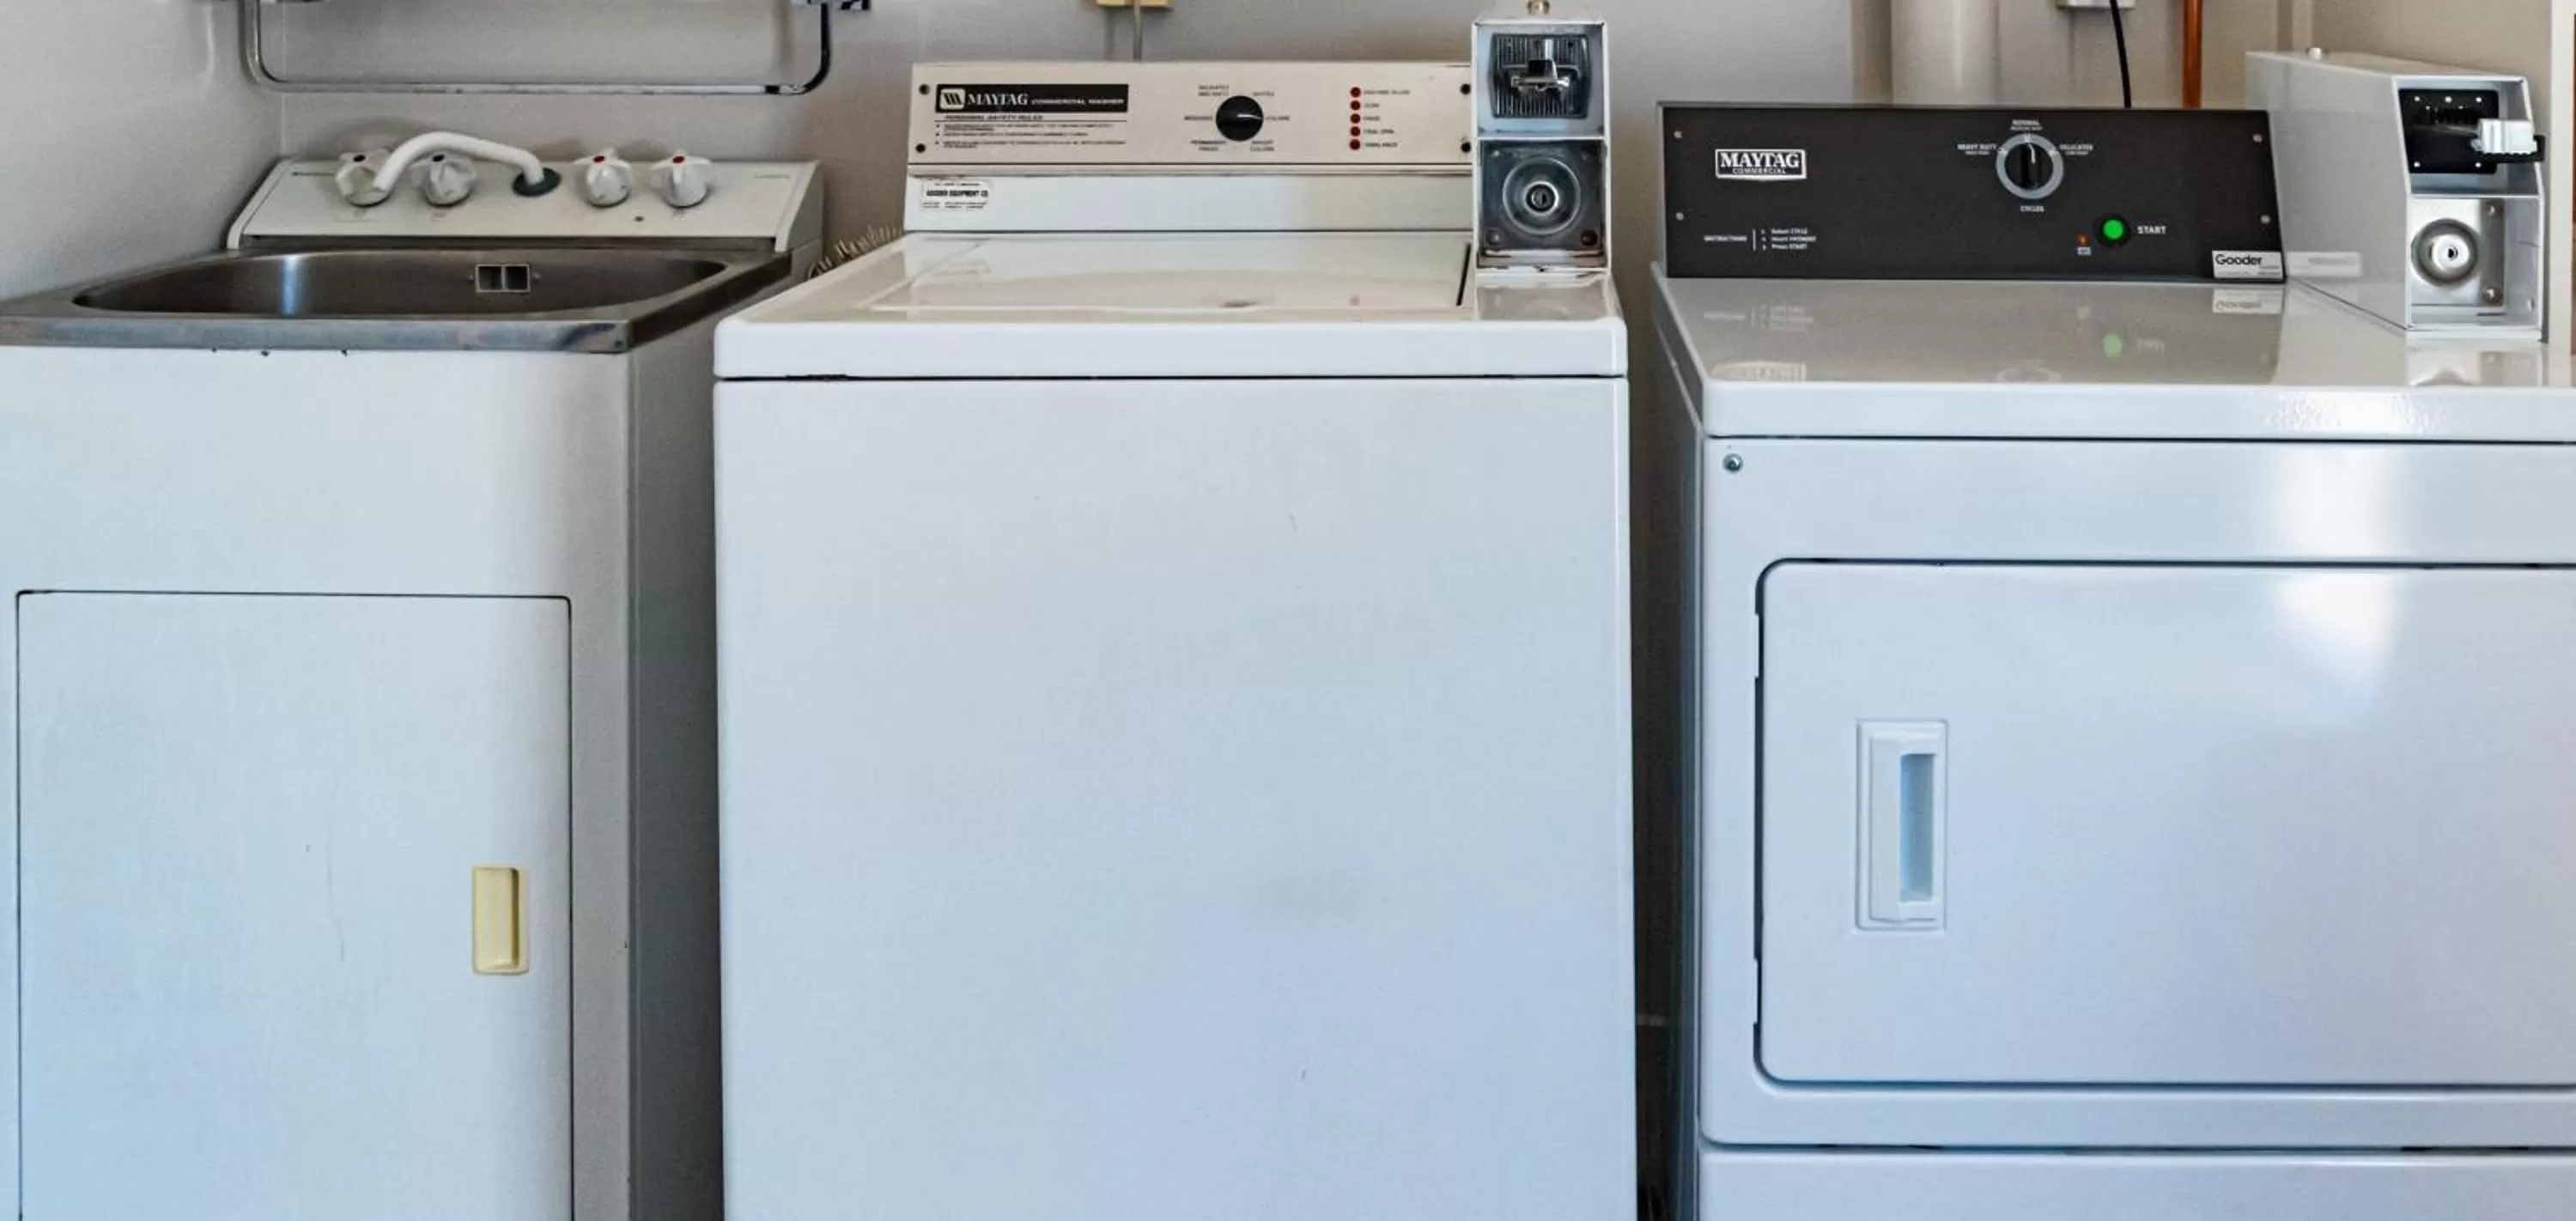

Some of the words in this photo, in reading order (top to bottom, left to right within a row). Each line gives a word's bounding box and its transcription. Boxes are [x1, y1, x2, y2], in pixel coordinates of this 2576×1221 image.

[968, 93, 1029, 106] MAYTAG
[1720, 152, 1800, 167] MAYTAG
[2136, 225, 2166, 234] START
[2215, 253, 2263, 265] Gooder
